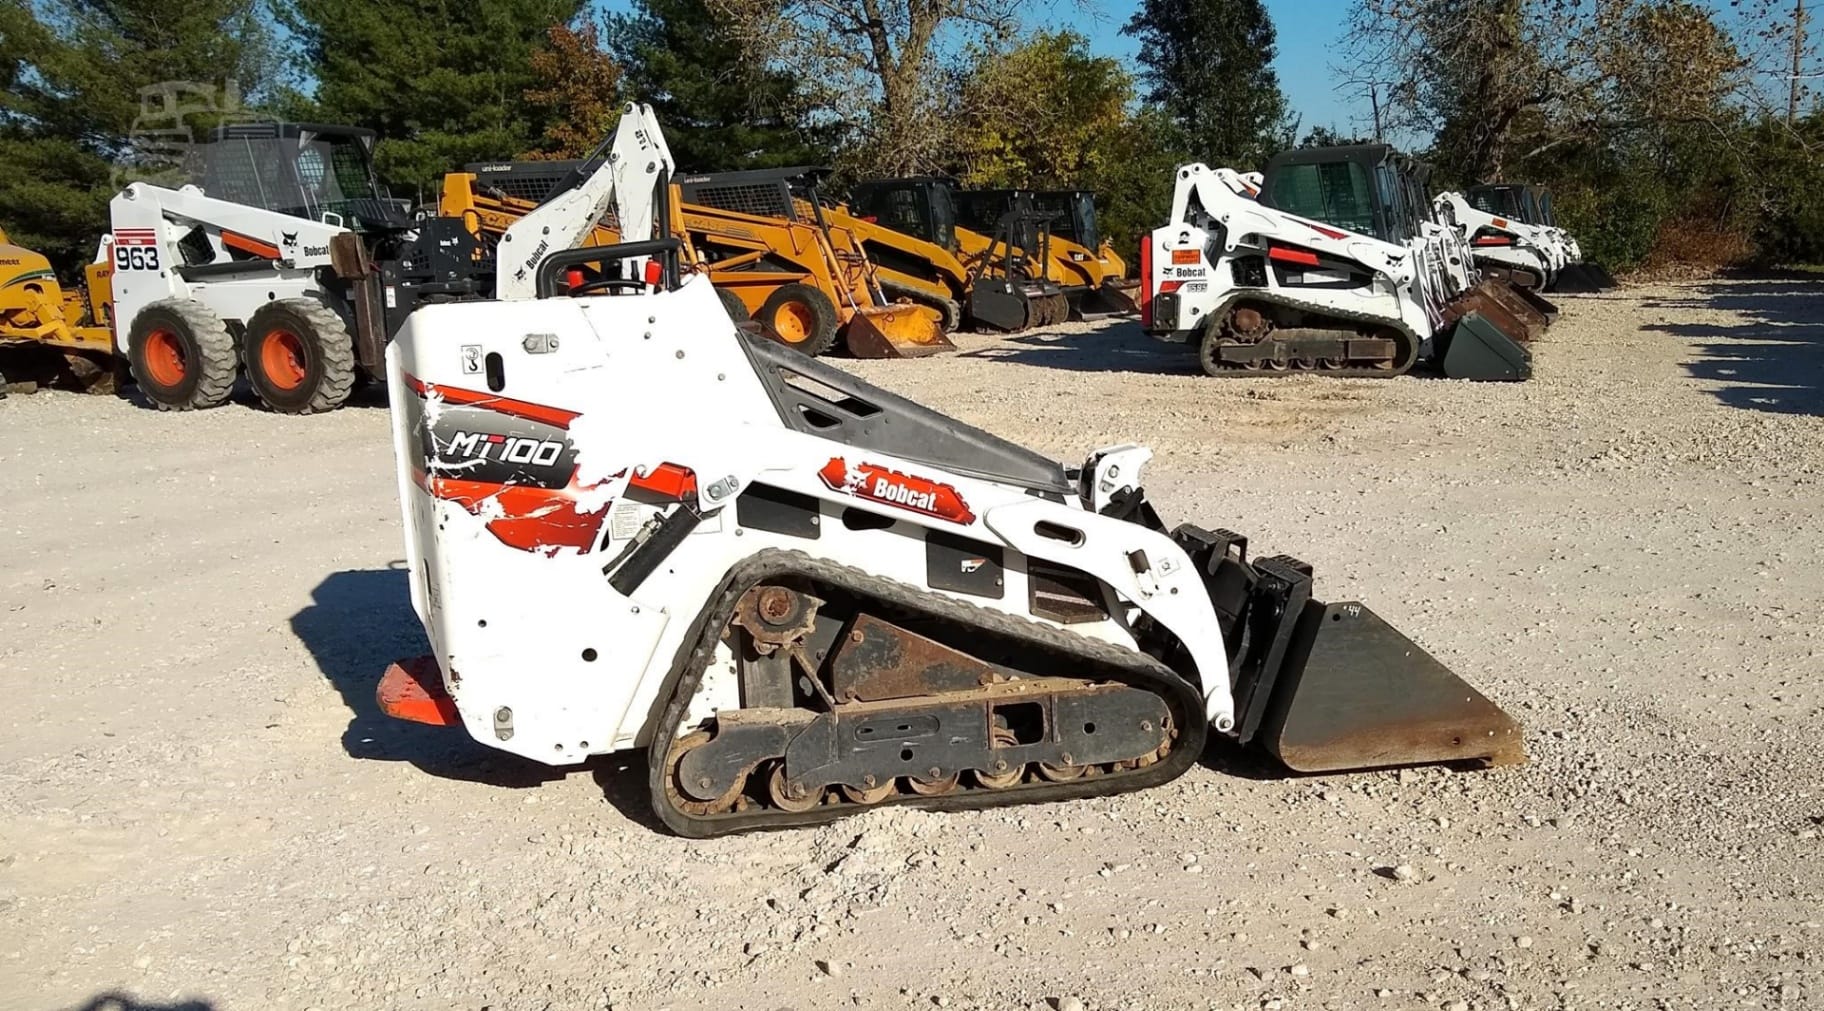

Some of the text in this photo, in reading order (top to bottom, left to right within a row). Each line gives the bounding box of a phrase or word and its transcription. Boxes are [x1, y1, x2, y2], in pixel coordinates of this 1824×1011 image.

[116, 246, 159, 270] 963
[304, 244, 330, 257] Bobcat
[526, 240, 549, 270] Bobcat
[1177, 268, 1206, 277] Bobcat
[446, 431, 564, 467] MT100
[872, 478, 938, 511] Bobcat
